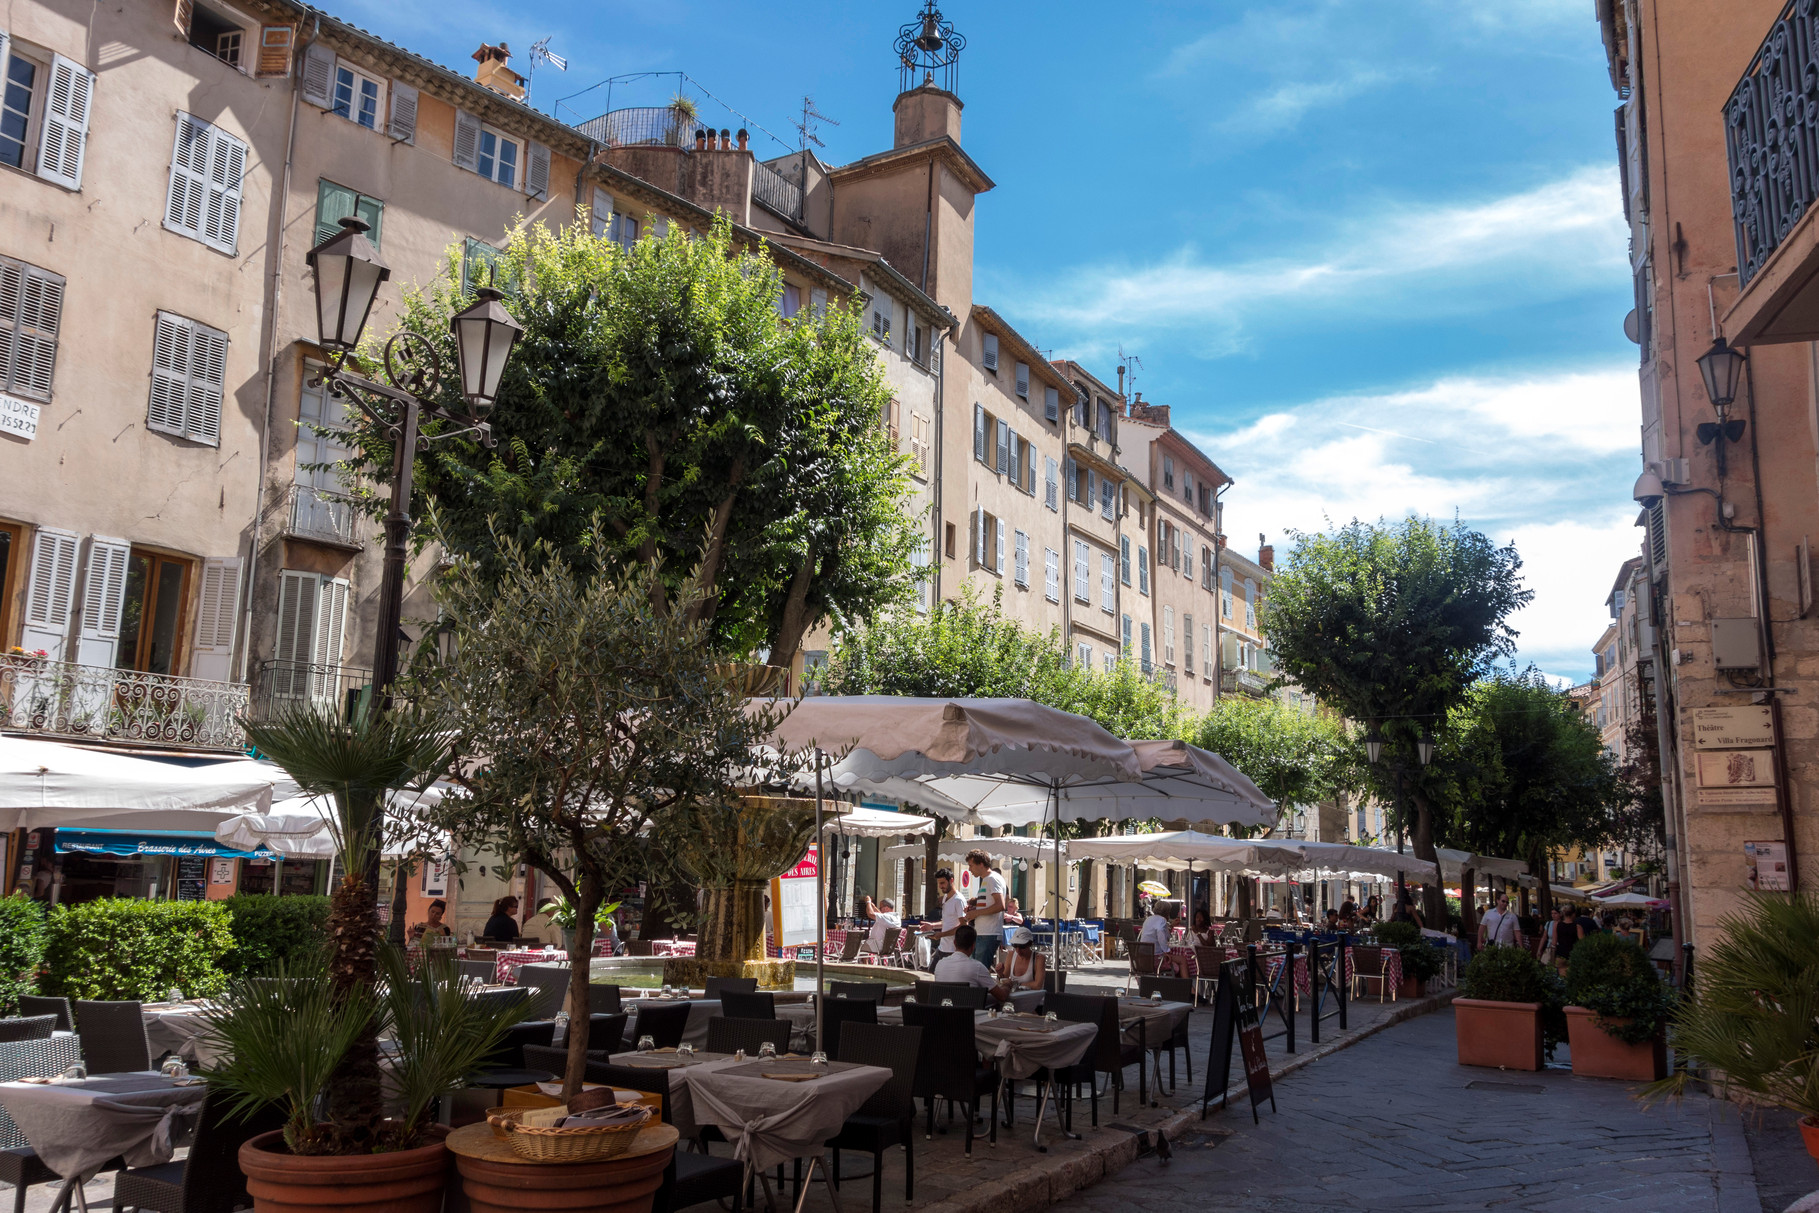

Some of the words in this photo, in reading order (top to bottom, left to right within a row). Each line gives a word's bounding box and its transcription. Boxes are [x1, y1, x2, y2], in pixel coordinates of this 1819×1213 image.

[1697, 724, 1724, 732] Théâtre
[1735, 736, 1773, 745] Fragonard
[61, 842, 104, 850] RESTAURANT
[137, 841, 176, 853] Brasserie
[178, 844, 192, 854] des
[193, 843, 216, 855] Aires
[787, 867, 799, 877] DES
[800, 866, 816, 876] AIRES
